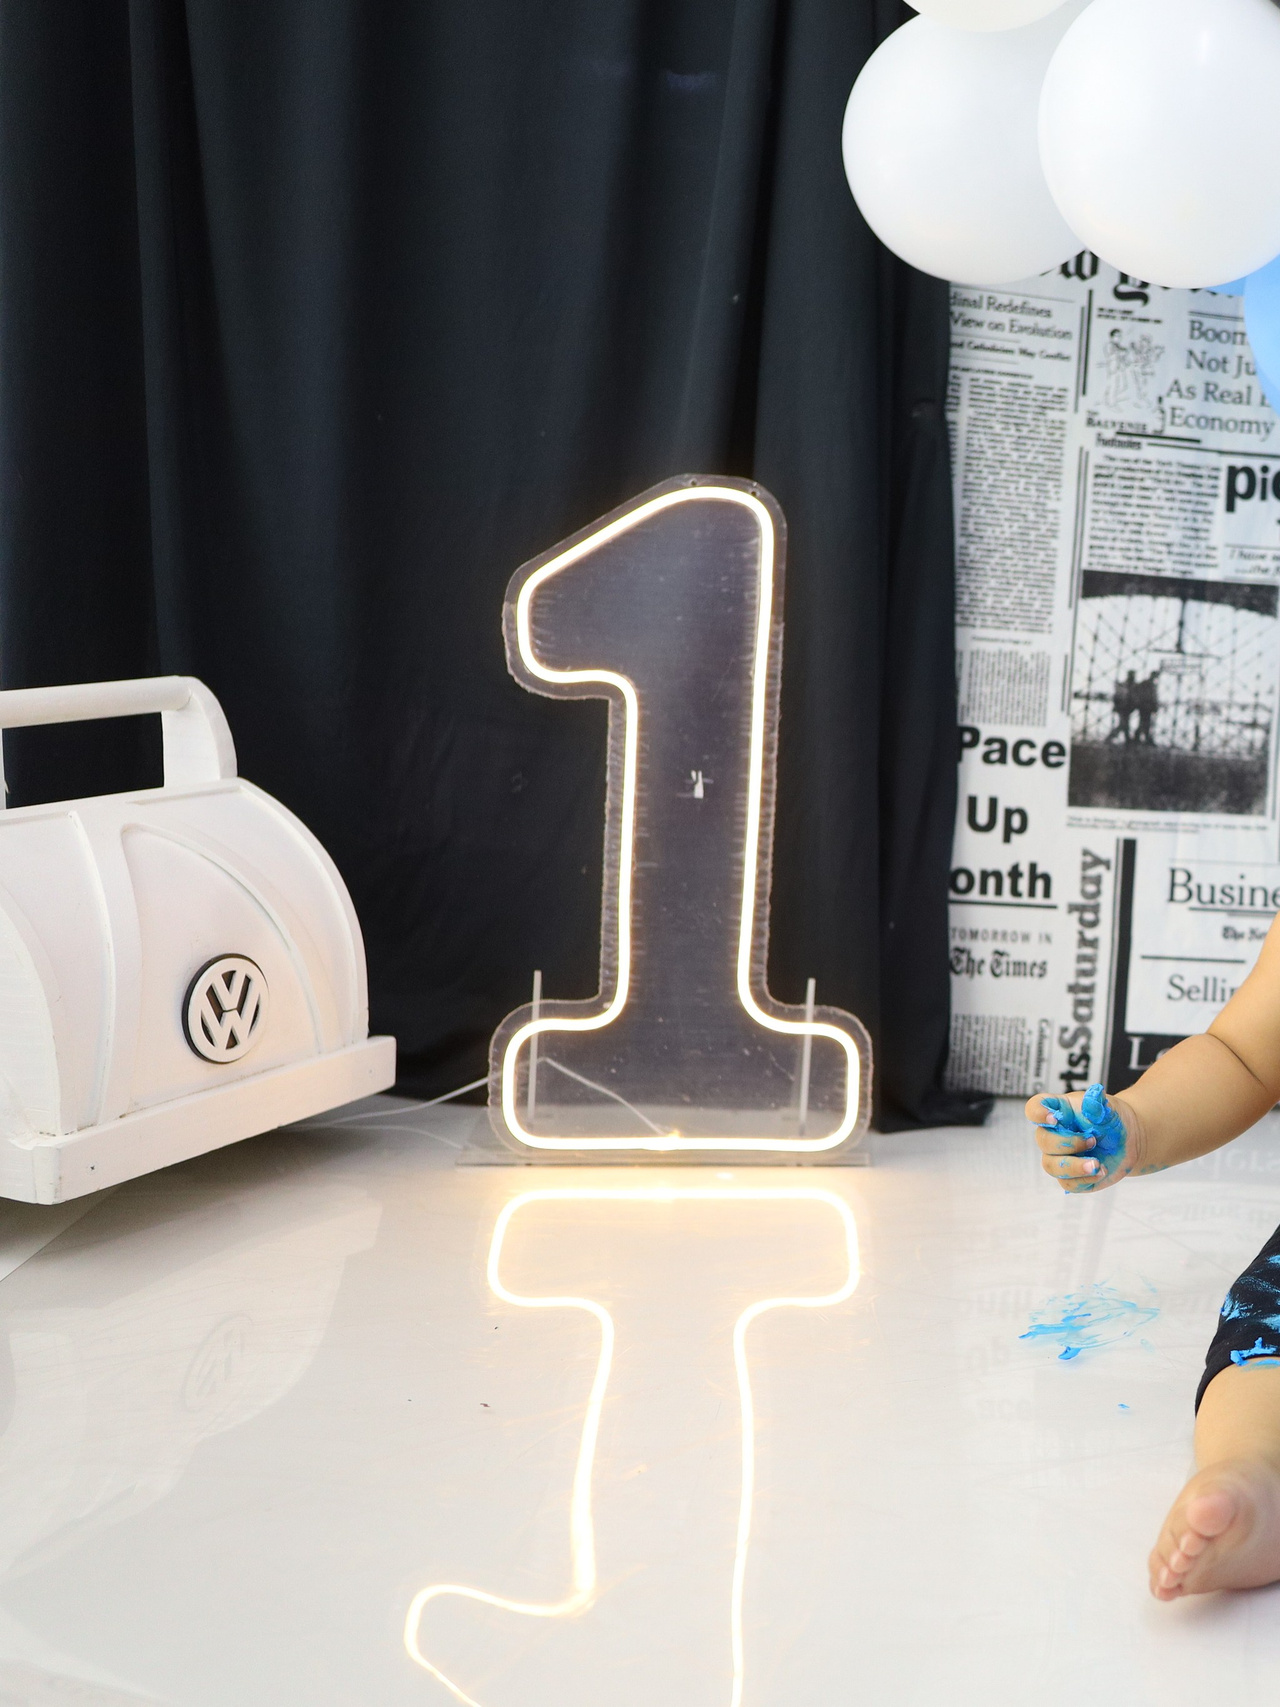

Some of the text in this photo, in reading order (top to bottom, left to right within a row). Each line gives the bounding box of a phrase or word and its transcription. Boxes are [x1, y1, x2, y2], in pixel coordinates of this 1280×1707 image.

[1185, 349, 1229, 374] Not
[1165, 379, 1198, 400] As
[1203, 381, 1252, 407] Real
[1168, 405, 1277, 443] Economy
[957, 724, 1067, 770] Pace
[499, 483, 864, 1155] 1
[967, 794, 1029, 844] Up
[951, 926, 1053, 944] TOMORROW IN
[950, 946, 1048, 980] The Times
